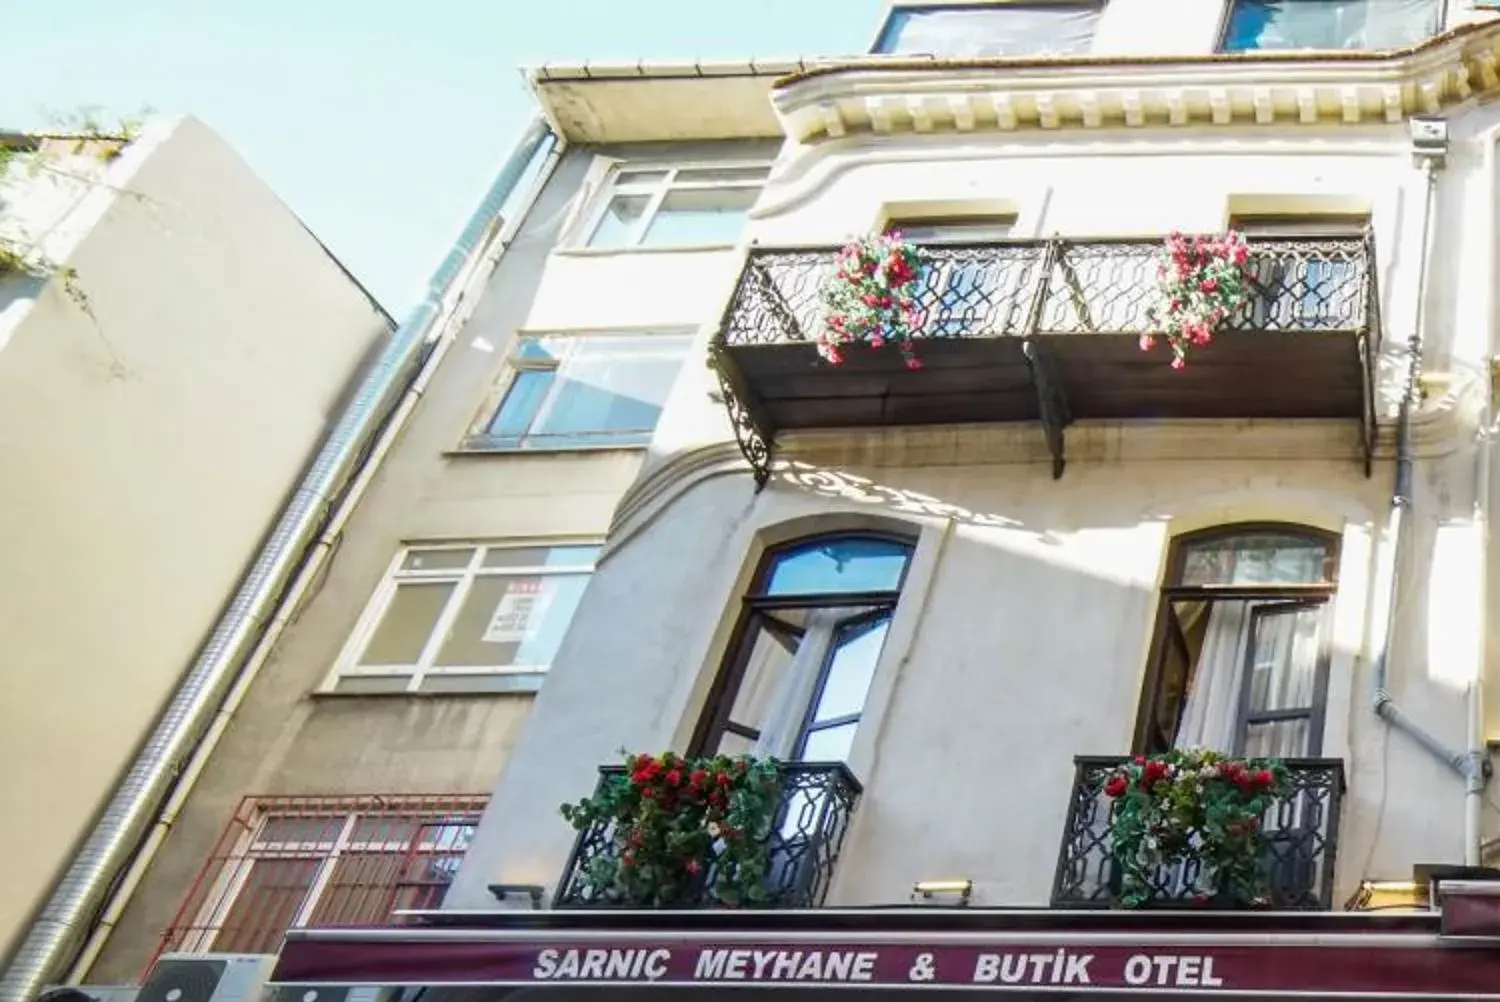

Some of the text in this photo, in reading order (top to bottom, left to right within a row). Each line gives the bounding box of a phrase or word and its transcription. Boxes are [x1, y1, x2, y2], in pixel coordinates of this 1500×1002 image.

[693, 949, 878, 981] MEYHANE
[908, 953, 936, 982] &
[973, 947, 1095, 985] BUTİK
[1123, 954, 1224, 987] OTEL
